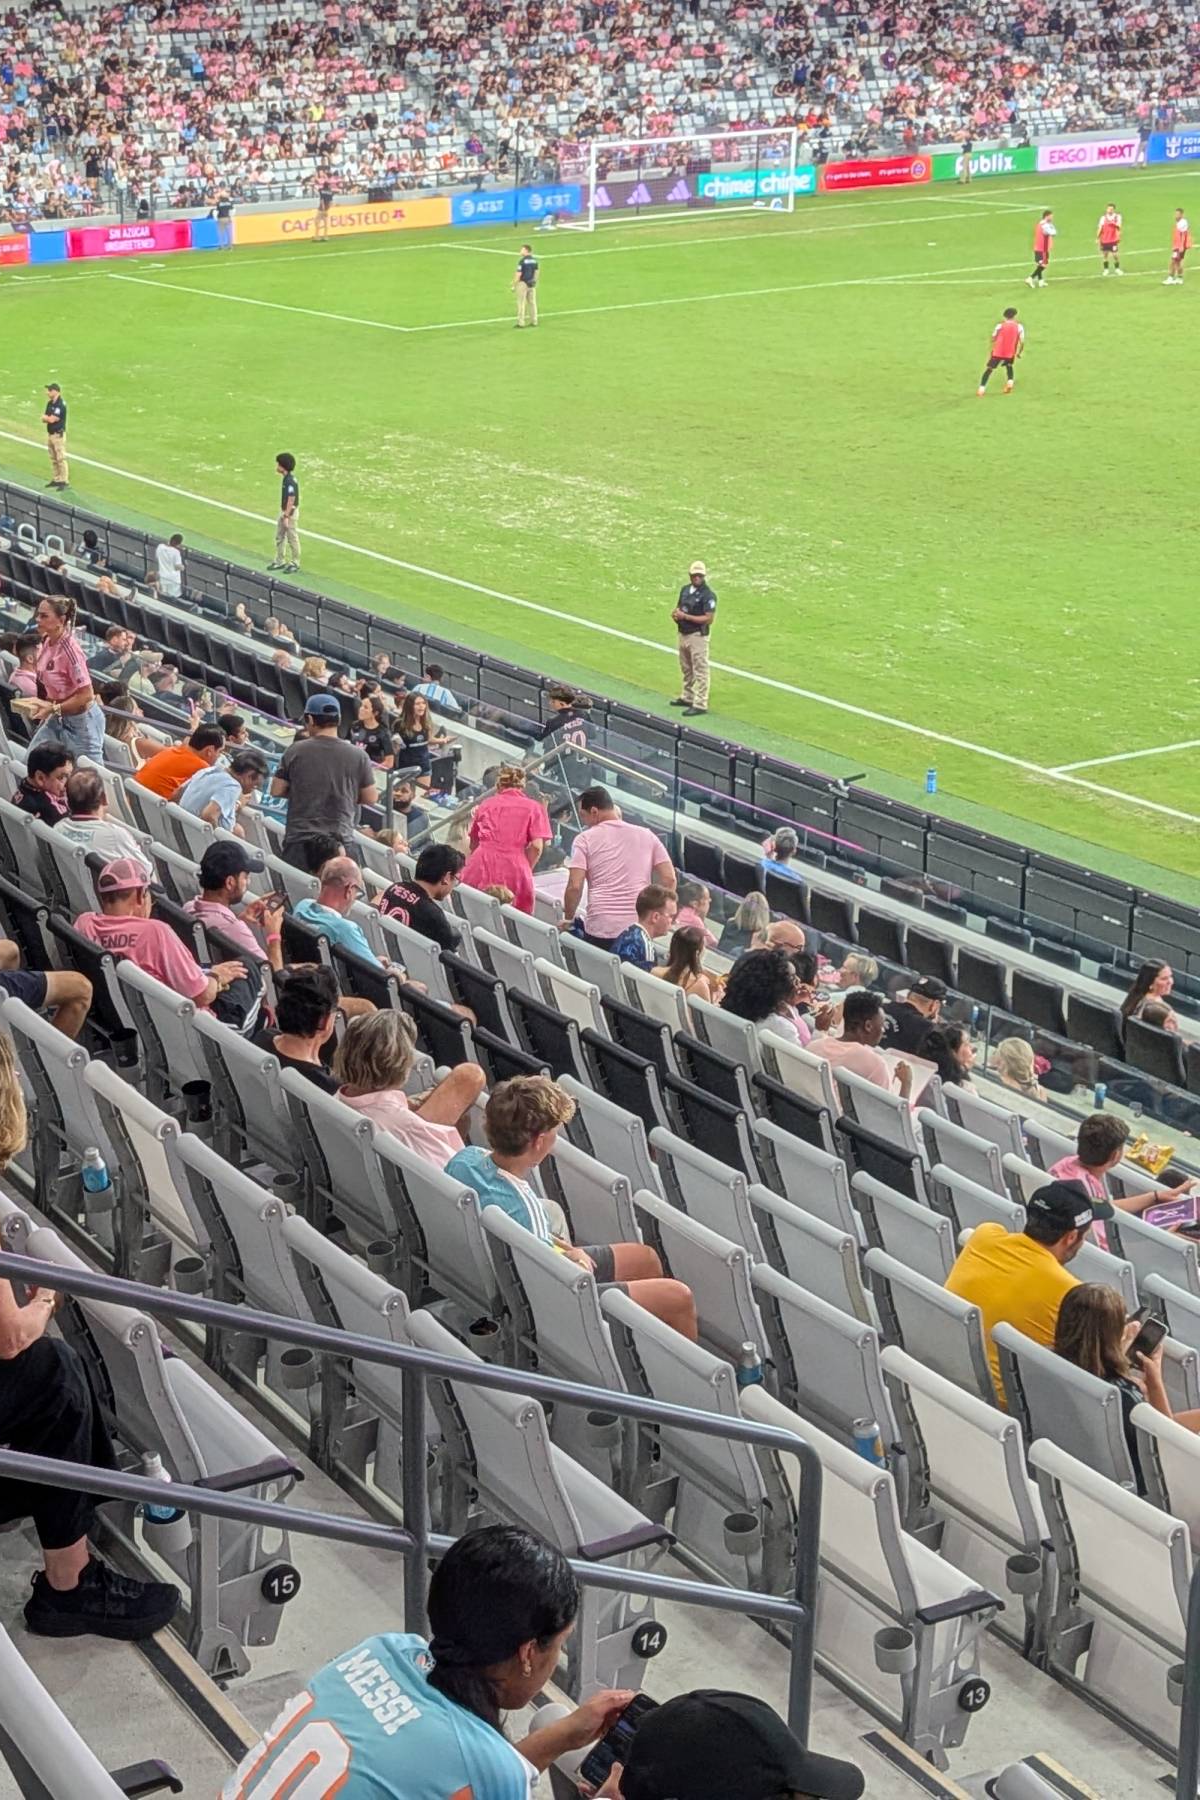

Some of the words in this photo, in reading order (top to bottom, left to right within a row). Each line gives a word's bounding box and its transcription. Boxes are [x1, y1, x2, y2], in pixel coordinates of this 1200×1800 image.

[1049, 148, 1087, 165] ERGO
[703, 175, 756, 198] chime
[760, 170, 812, 194] chime
[281, 217, 313, 234] CAF
[330, 209, 390, 228] BUSTELO
[93, 933, 139, 950] ENDE
[270, 1574, 295, 1597] 15
[640, 1631, 661, 1651] 14
[336, 1648, 423, 1736] MESSI
[966, 1686, 986, 1706] 13
